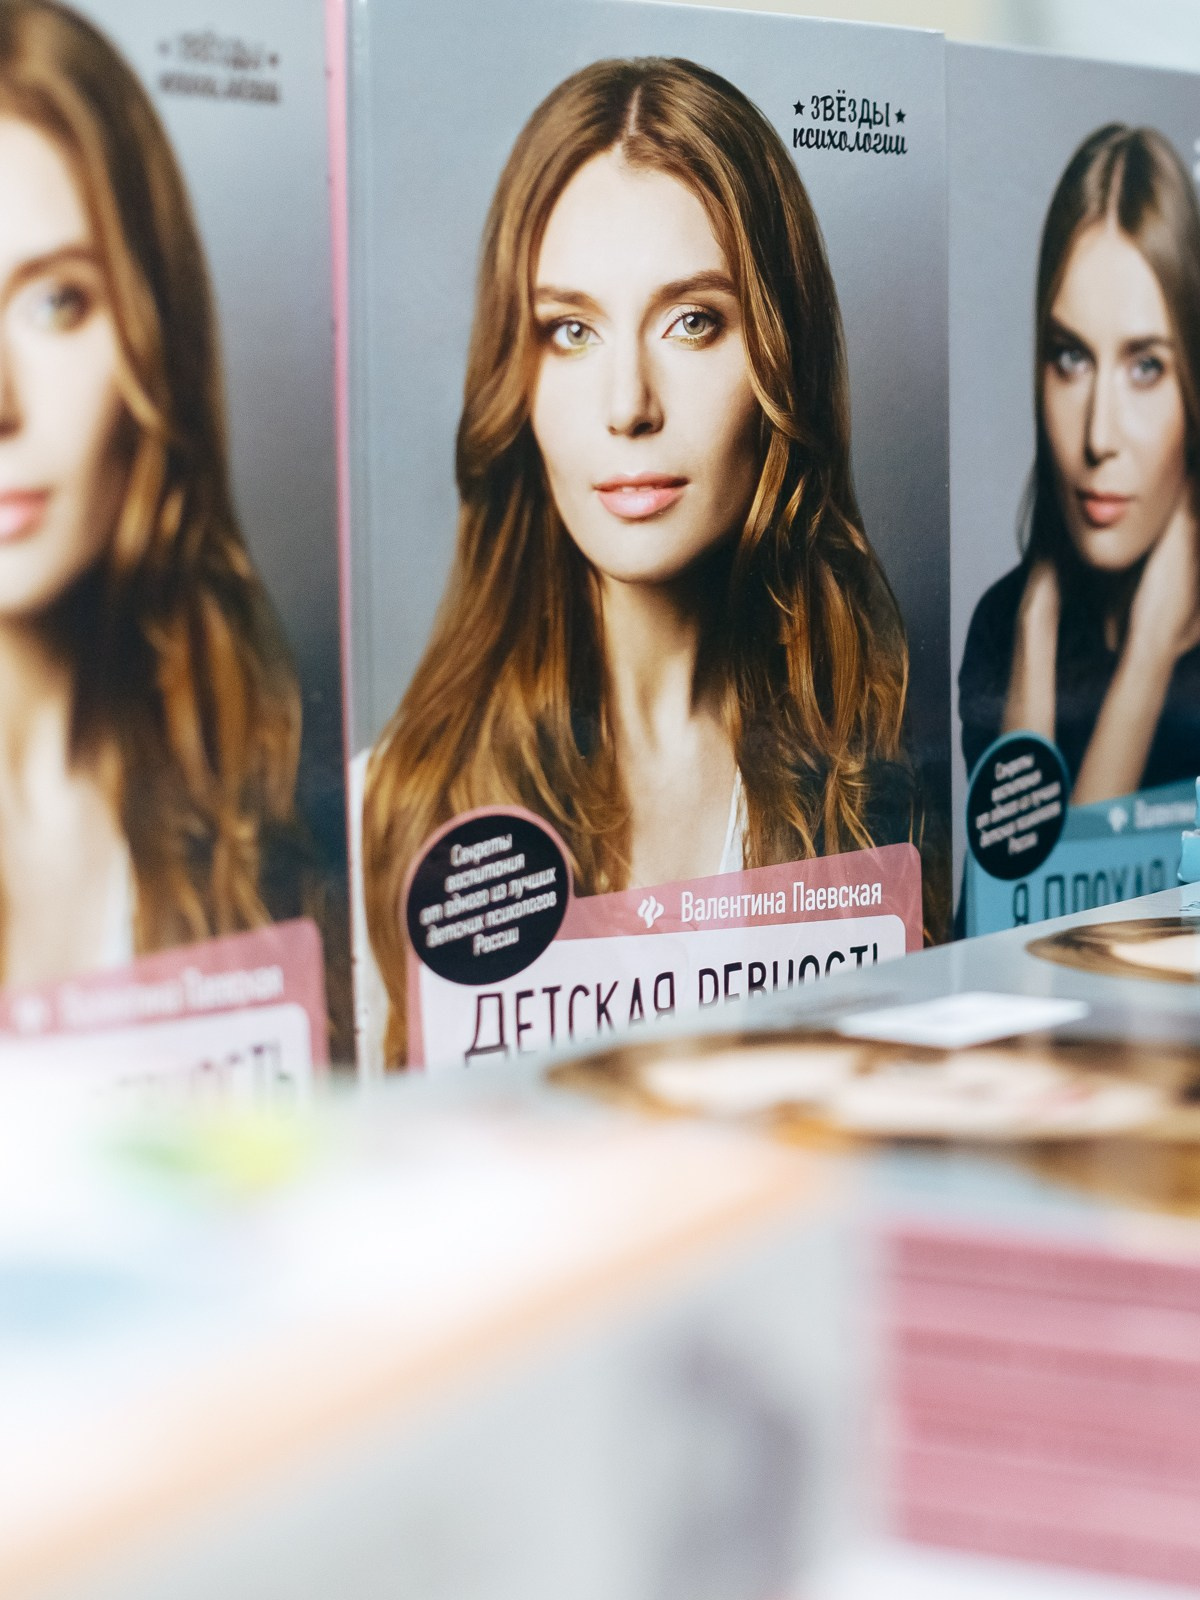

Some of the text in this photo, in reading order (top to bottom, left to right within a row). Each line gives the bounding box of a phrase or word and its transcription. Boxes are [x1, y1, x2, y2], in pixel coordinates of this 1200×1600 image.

[811, 89, 890, 129] ЗВЁЗДЫ
[792, 127, 908, 155] психологии
[681, 881, 882, 923] Валентина Паевская
